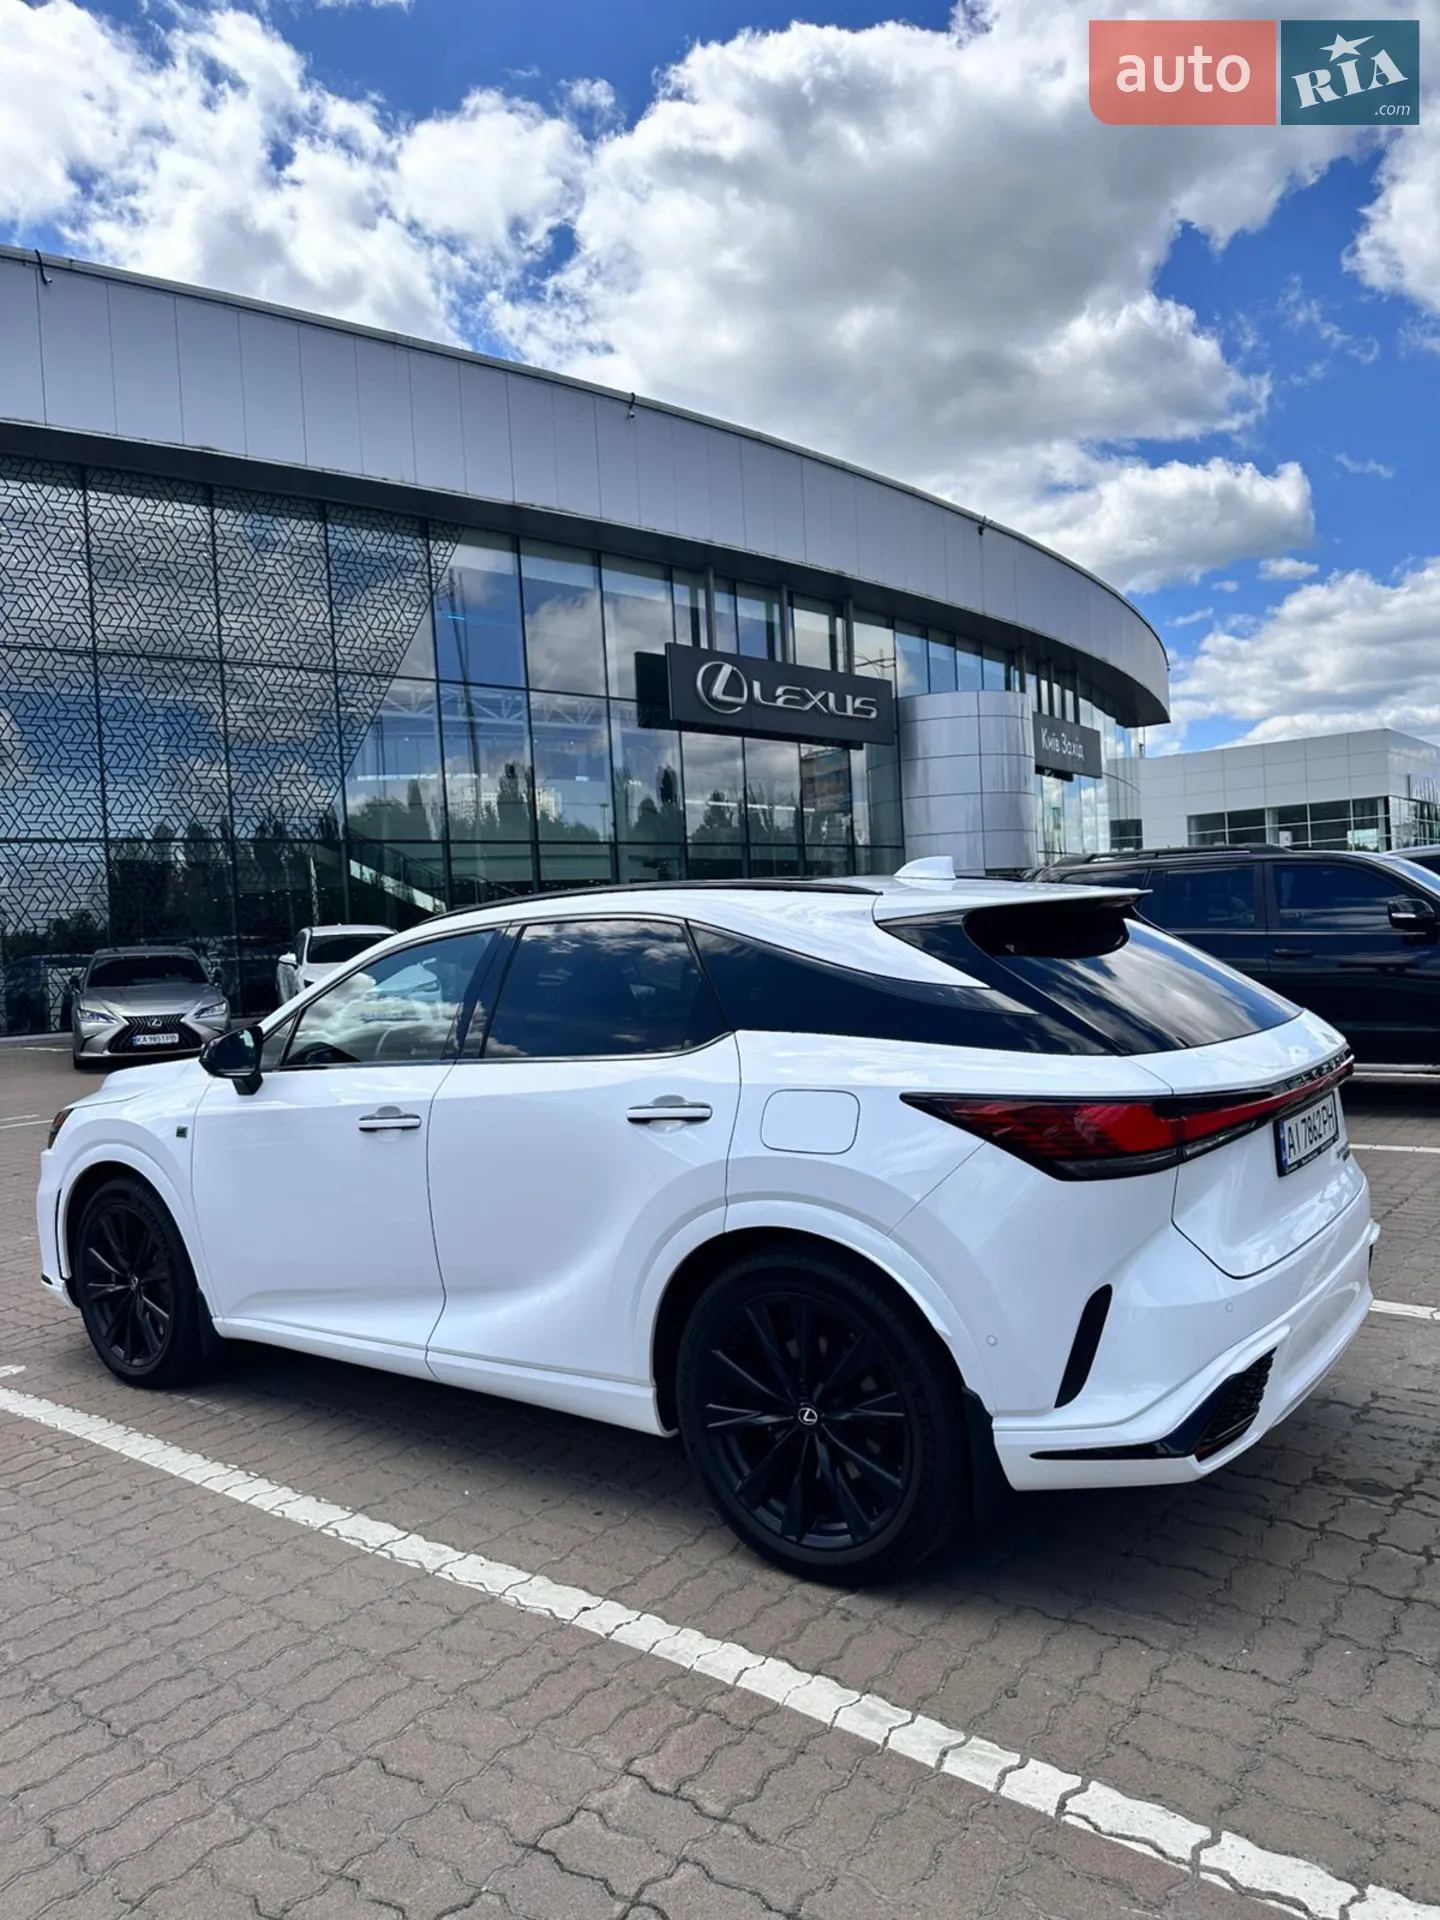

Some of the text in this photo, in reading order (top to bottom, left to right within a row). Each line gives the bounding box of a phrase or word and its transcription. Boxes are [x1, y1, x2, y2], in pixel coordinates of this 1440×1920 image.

[752, 679, 878, 719] LEXUS
[1041, 727, 1085, 761] Київ Захід
